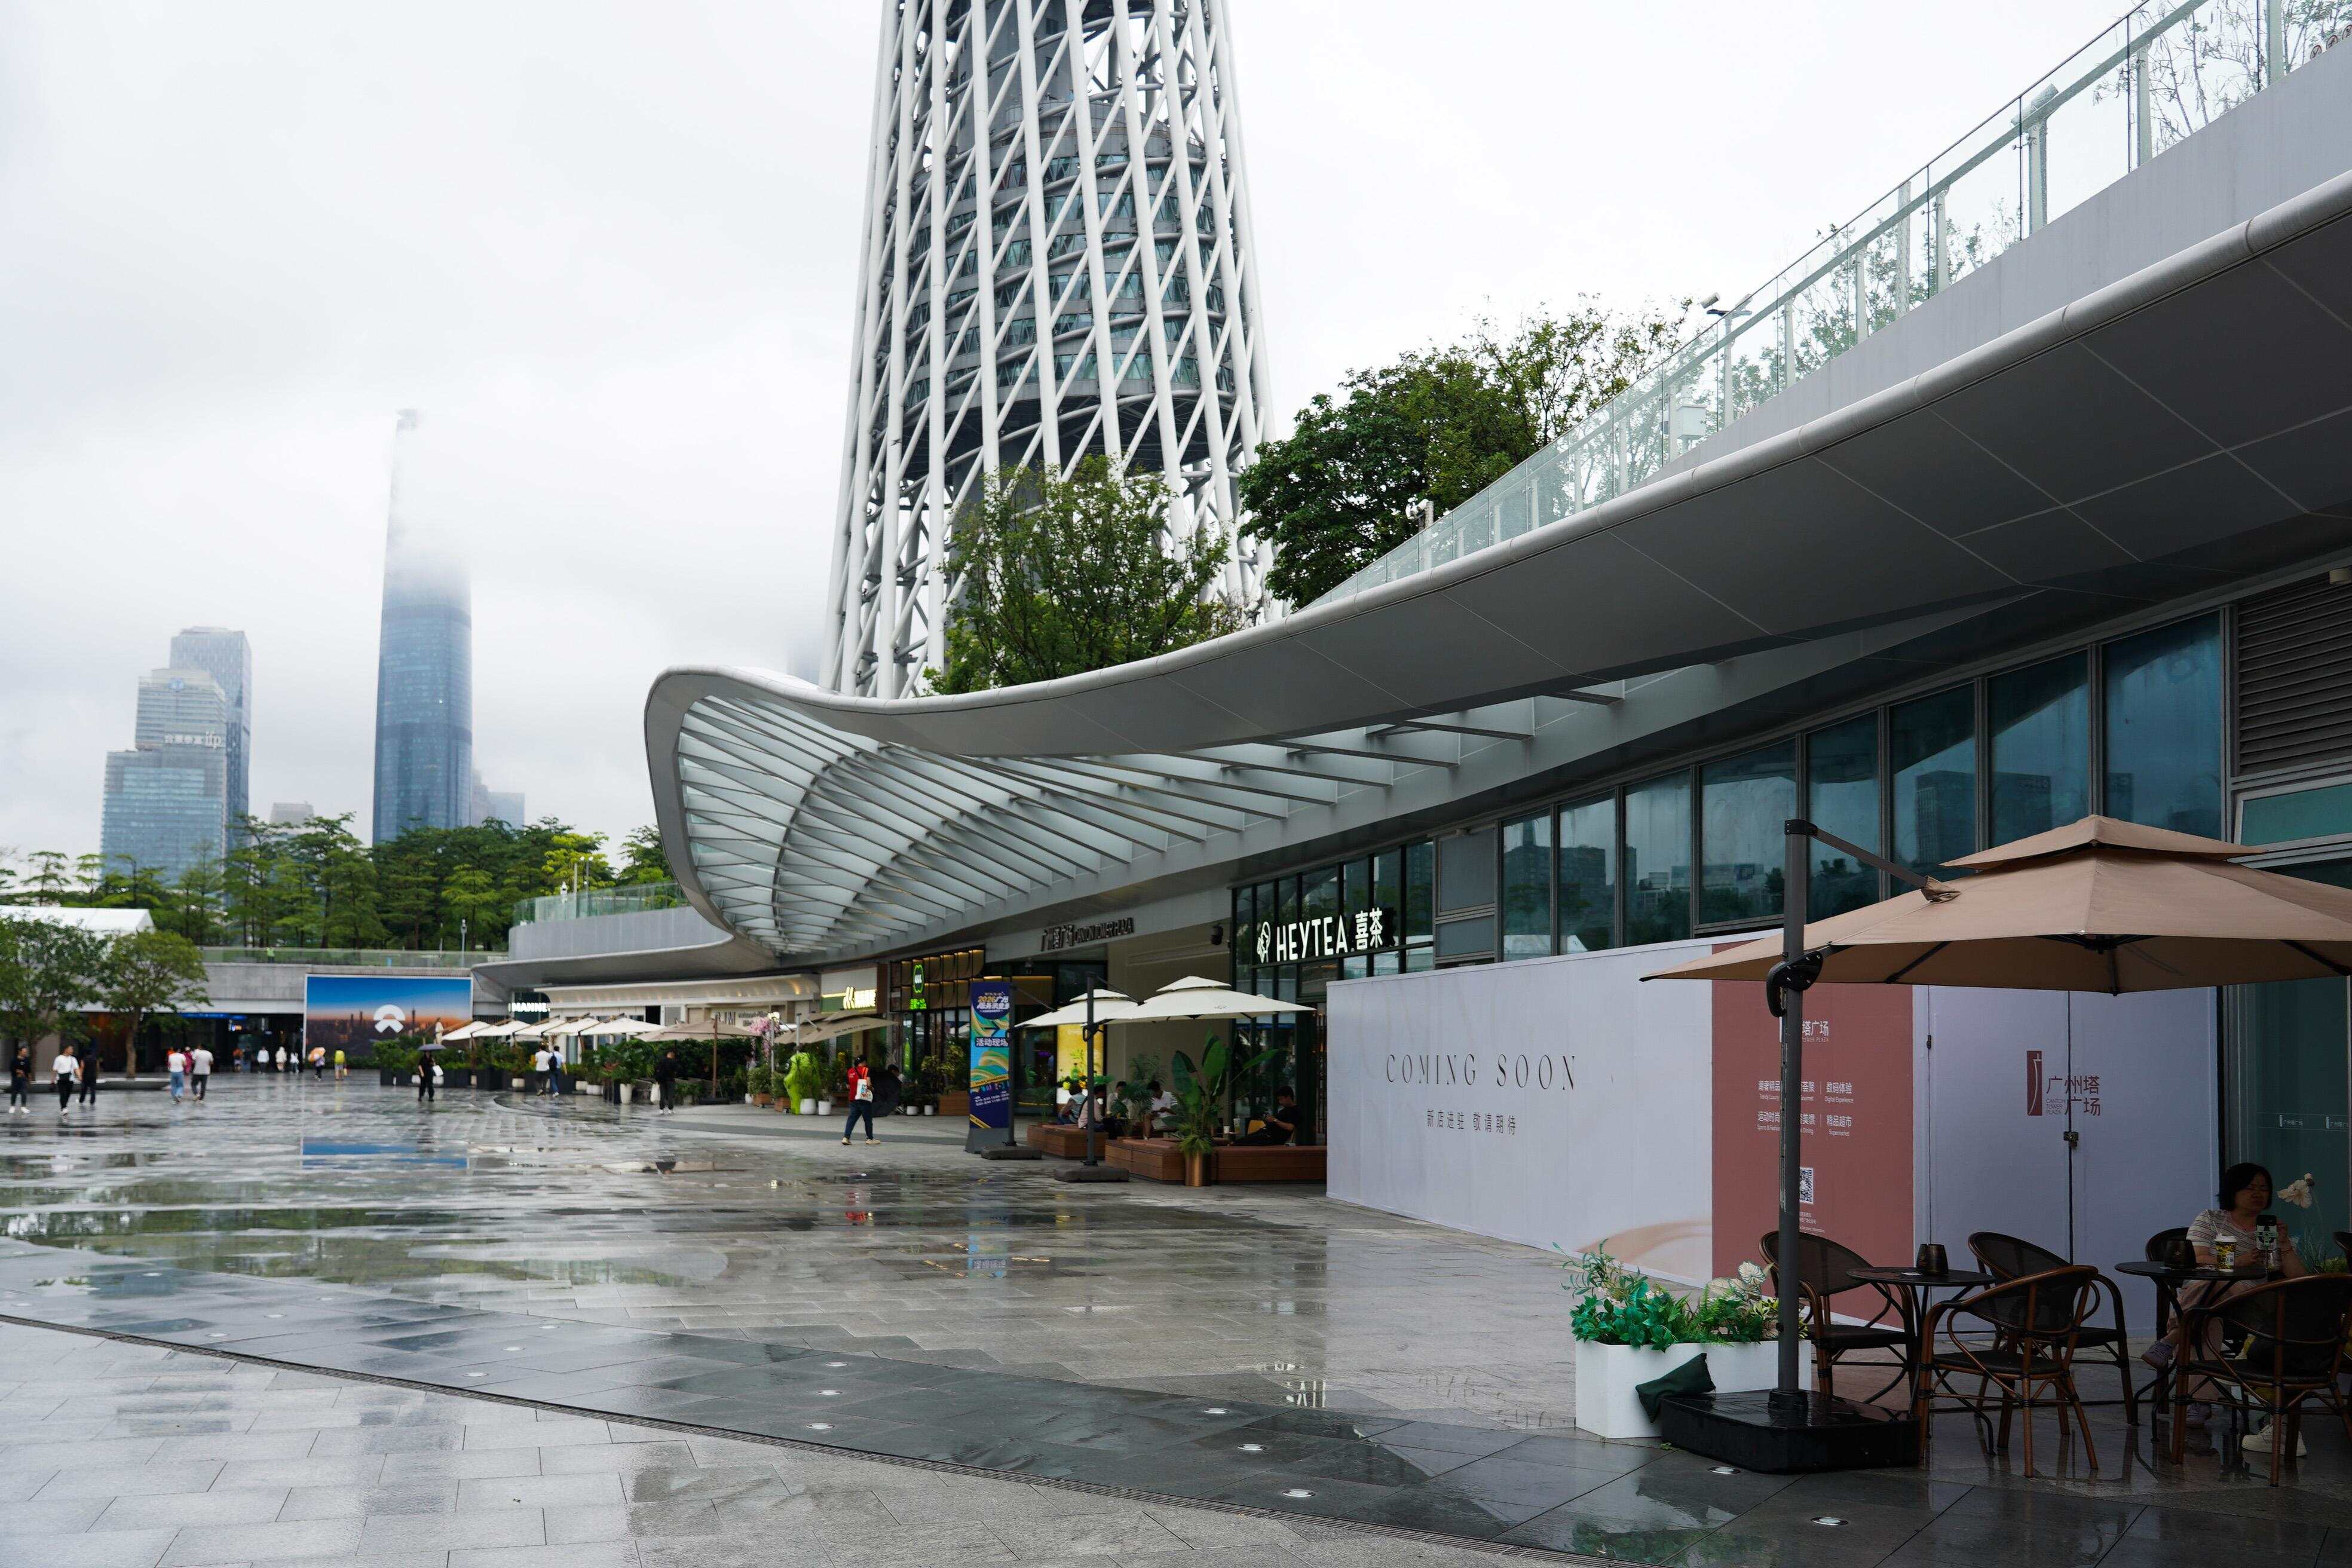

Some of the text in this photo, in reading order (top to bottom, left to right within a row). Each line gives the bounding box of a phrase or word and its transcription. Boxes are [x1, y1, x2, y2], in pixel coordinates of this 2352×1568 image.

[1276, 907, 1383, 962] HEYTEA 喜茶
[1802, 1019, 1829, 1036] 塔广场
[1386, 1054, 1576, 1091] COMING SOON
[1801, 1081, 1815, 1093] 荟聚
[1826, 1082, 1852, 1094] 数码体验
[2046, 1075, 2100, 1094] 广州塔
[2065, 1096, 2100, 1116] 广场
[1427, 1108, 1516, 1135] 新店进驻 敬请期待
[1800, 1113, 1815, 1125] 美馔
[1827, 1115, 1852, 1128] 精品超市
